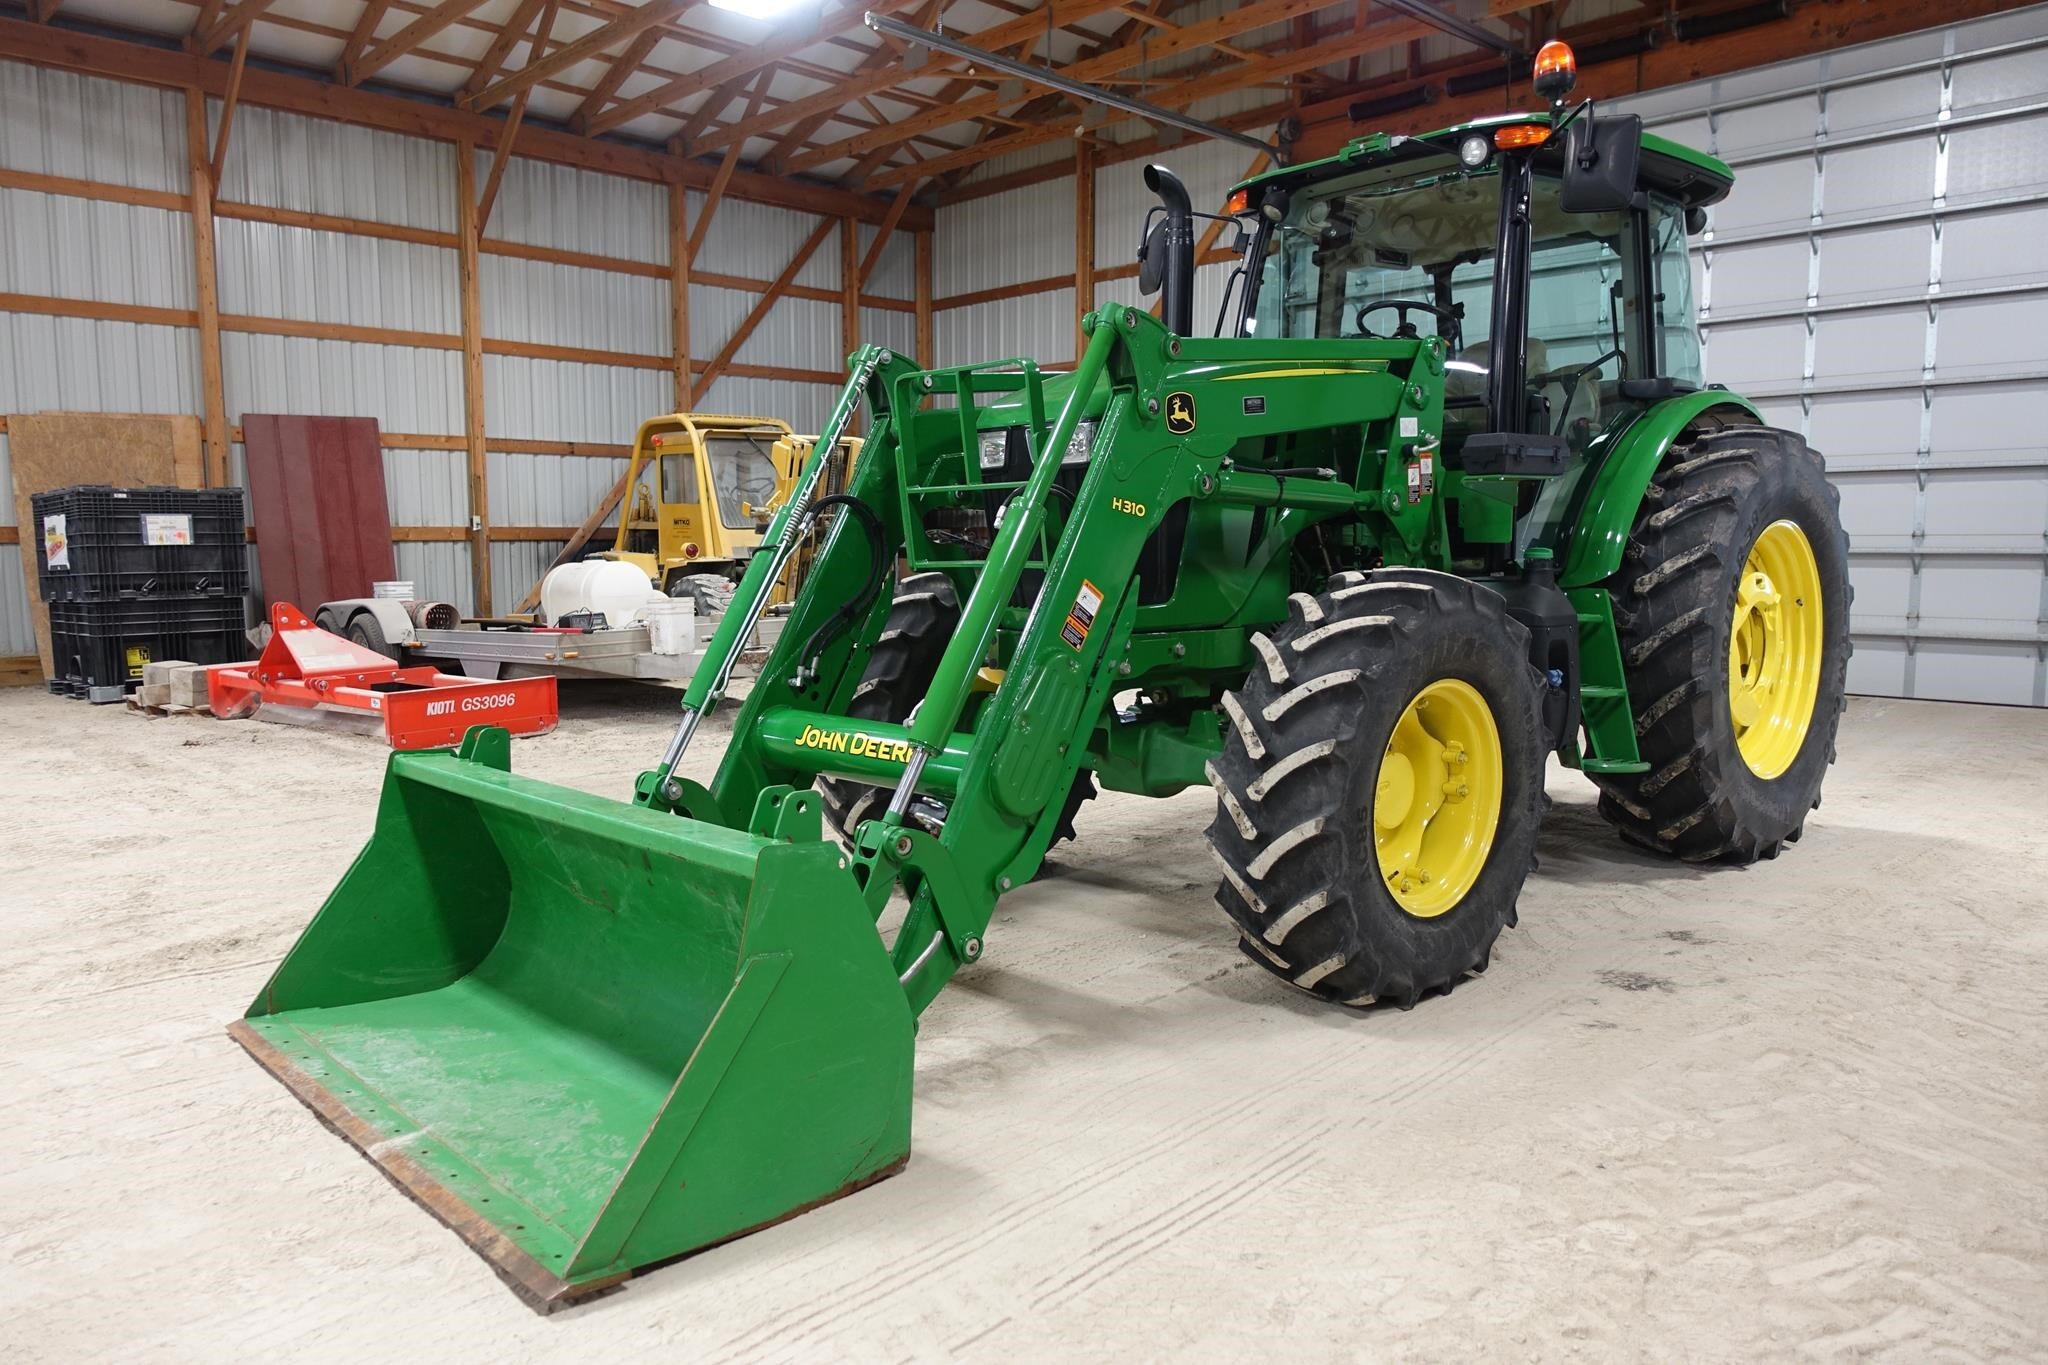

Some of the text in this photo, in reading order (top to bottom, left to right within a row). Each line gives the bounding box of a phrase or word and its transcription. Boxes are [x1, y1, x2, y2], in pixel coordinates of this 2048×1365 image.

[426, 692, 516, 716] KIOTI GS3096
[795, 724, 848, 753] JOHN
